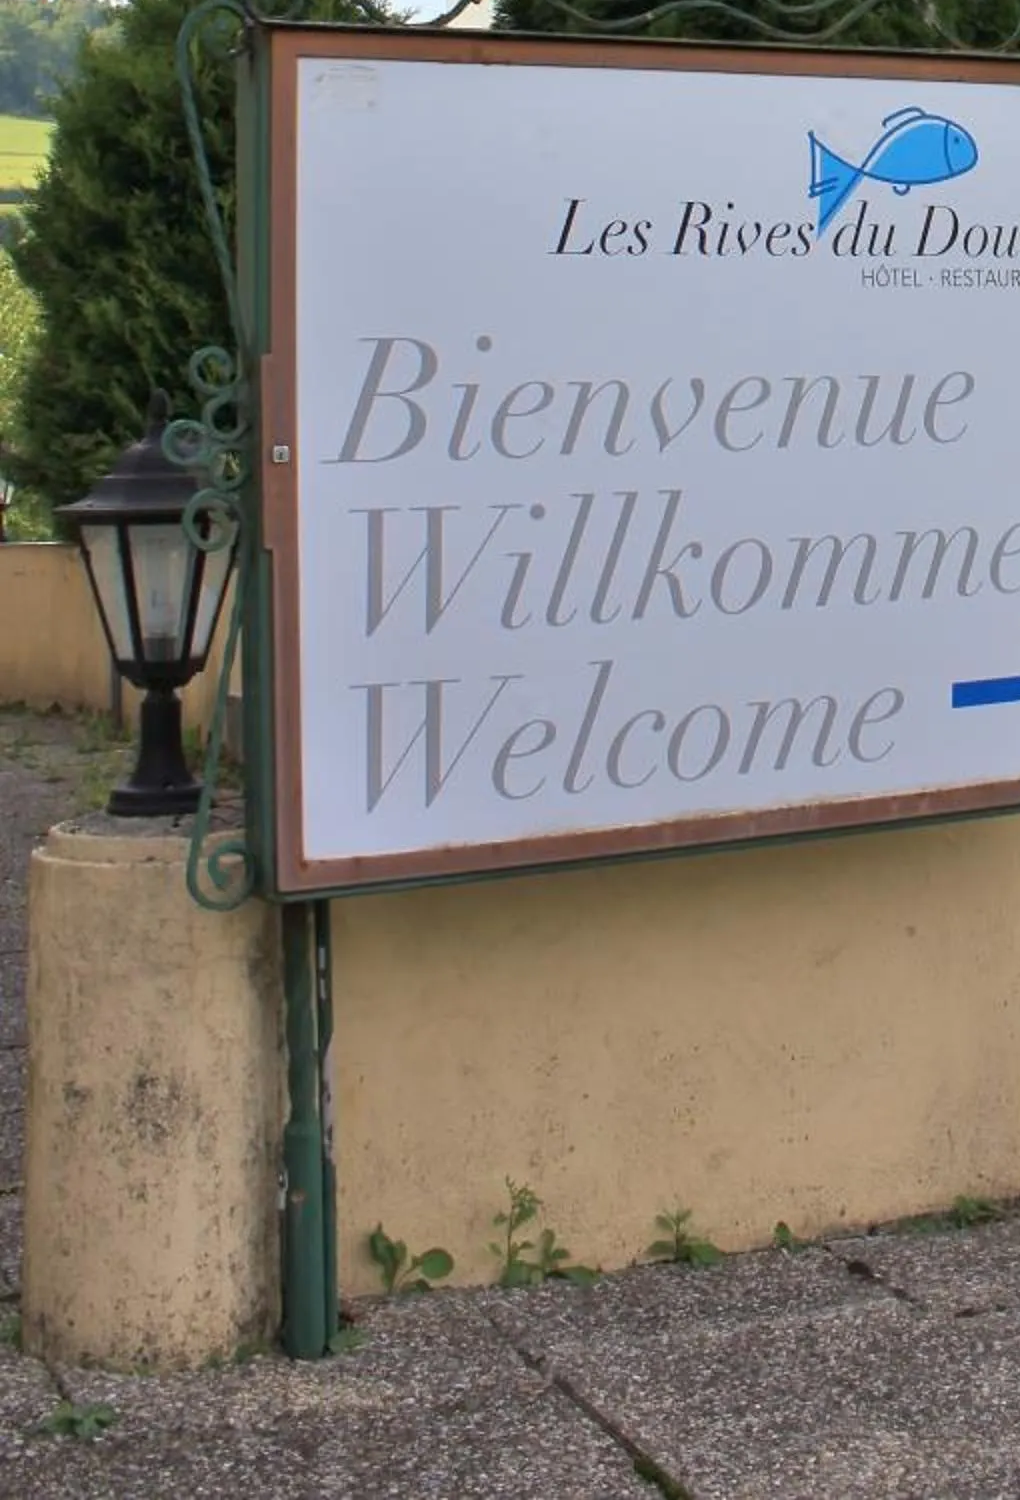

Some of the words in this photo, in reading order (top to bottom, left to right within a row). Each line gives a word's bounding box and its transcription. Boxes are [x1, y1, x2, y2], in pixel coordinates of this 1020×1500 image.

[548, 198, 652, 257] Les
[665, 201, 815, 258] Rives
[832, 199, 897, 258] du
[861, 265, 922, 288] HÔTEL
[320, 334, 975, 464] Bienvenue
[349, 661, 904, 815] Welcome
